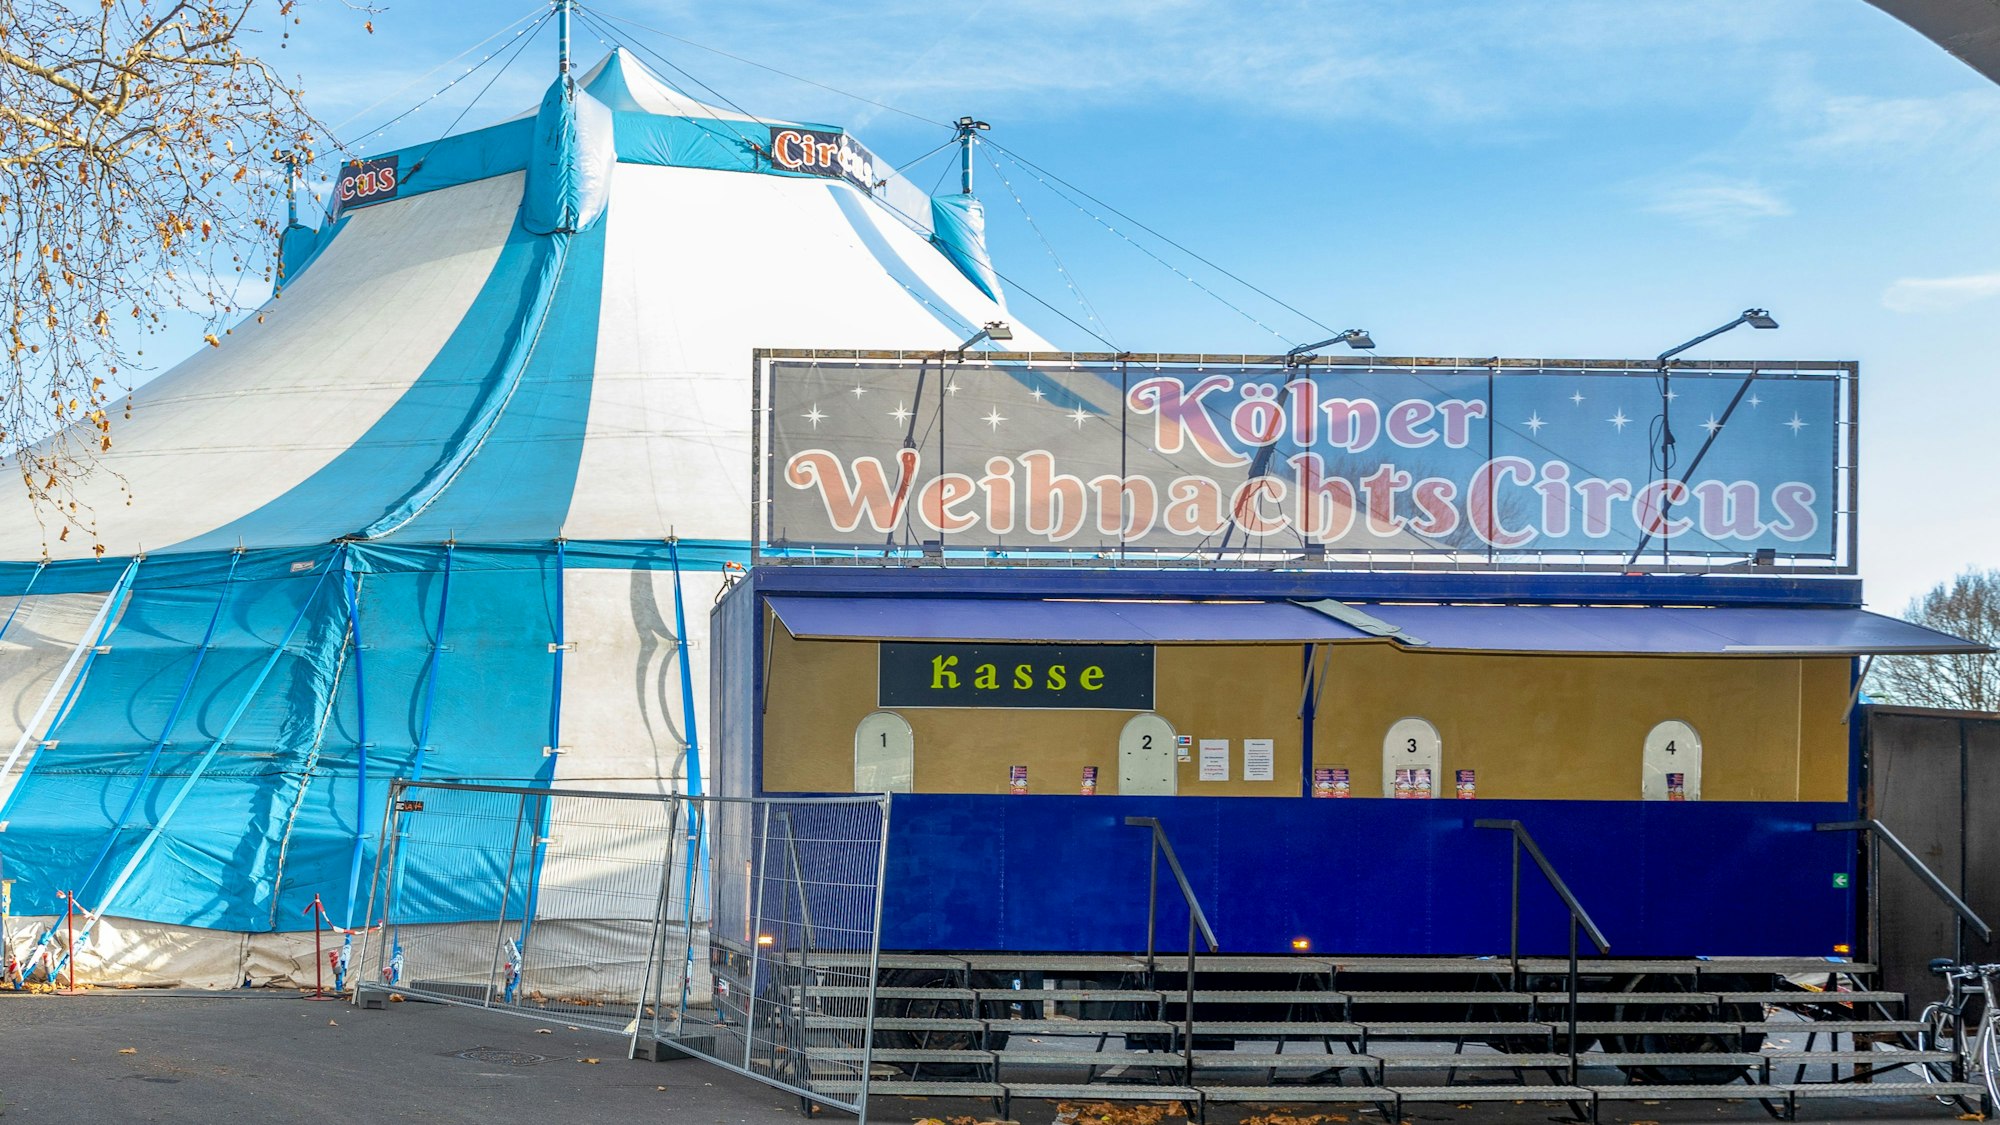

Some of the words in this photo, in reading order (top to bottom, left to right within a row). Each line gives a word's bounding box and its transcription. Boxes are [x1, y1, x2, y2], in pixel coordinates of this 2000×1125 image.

[1127, 375, 1486, 468] Kölner
[784, 449, 1818, 548] WeihnachtsCircus
[930, 655, 1104, 691] Kasse
[880, 733, 887, 748] 1
[1141, 735, 1153, 751] 2
[1407, 738, 1417, 753] 3
[1665, 740, 1677, 755] 4
